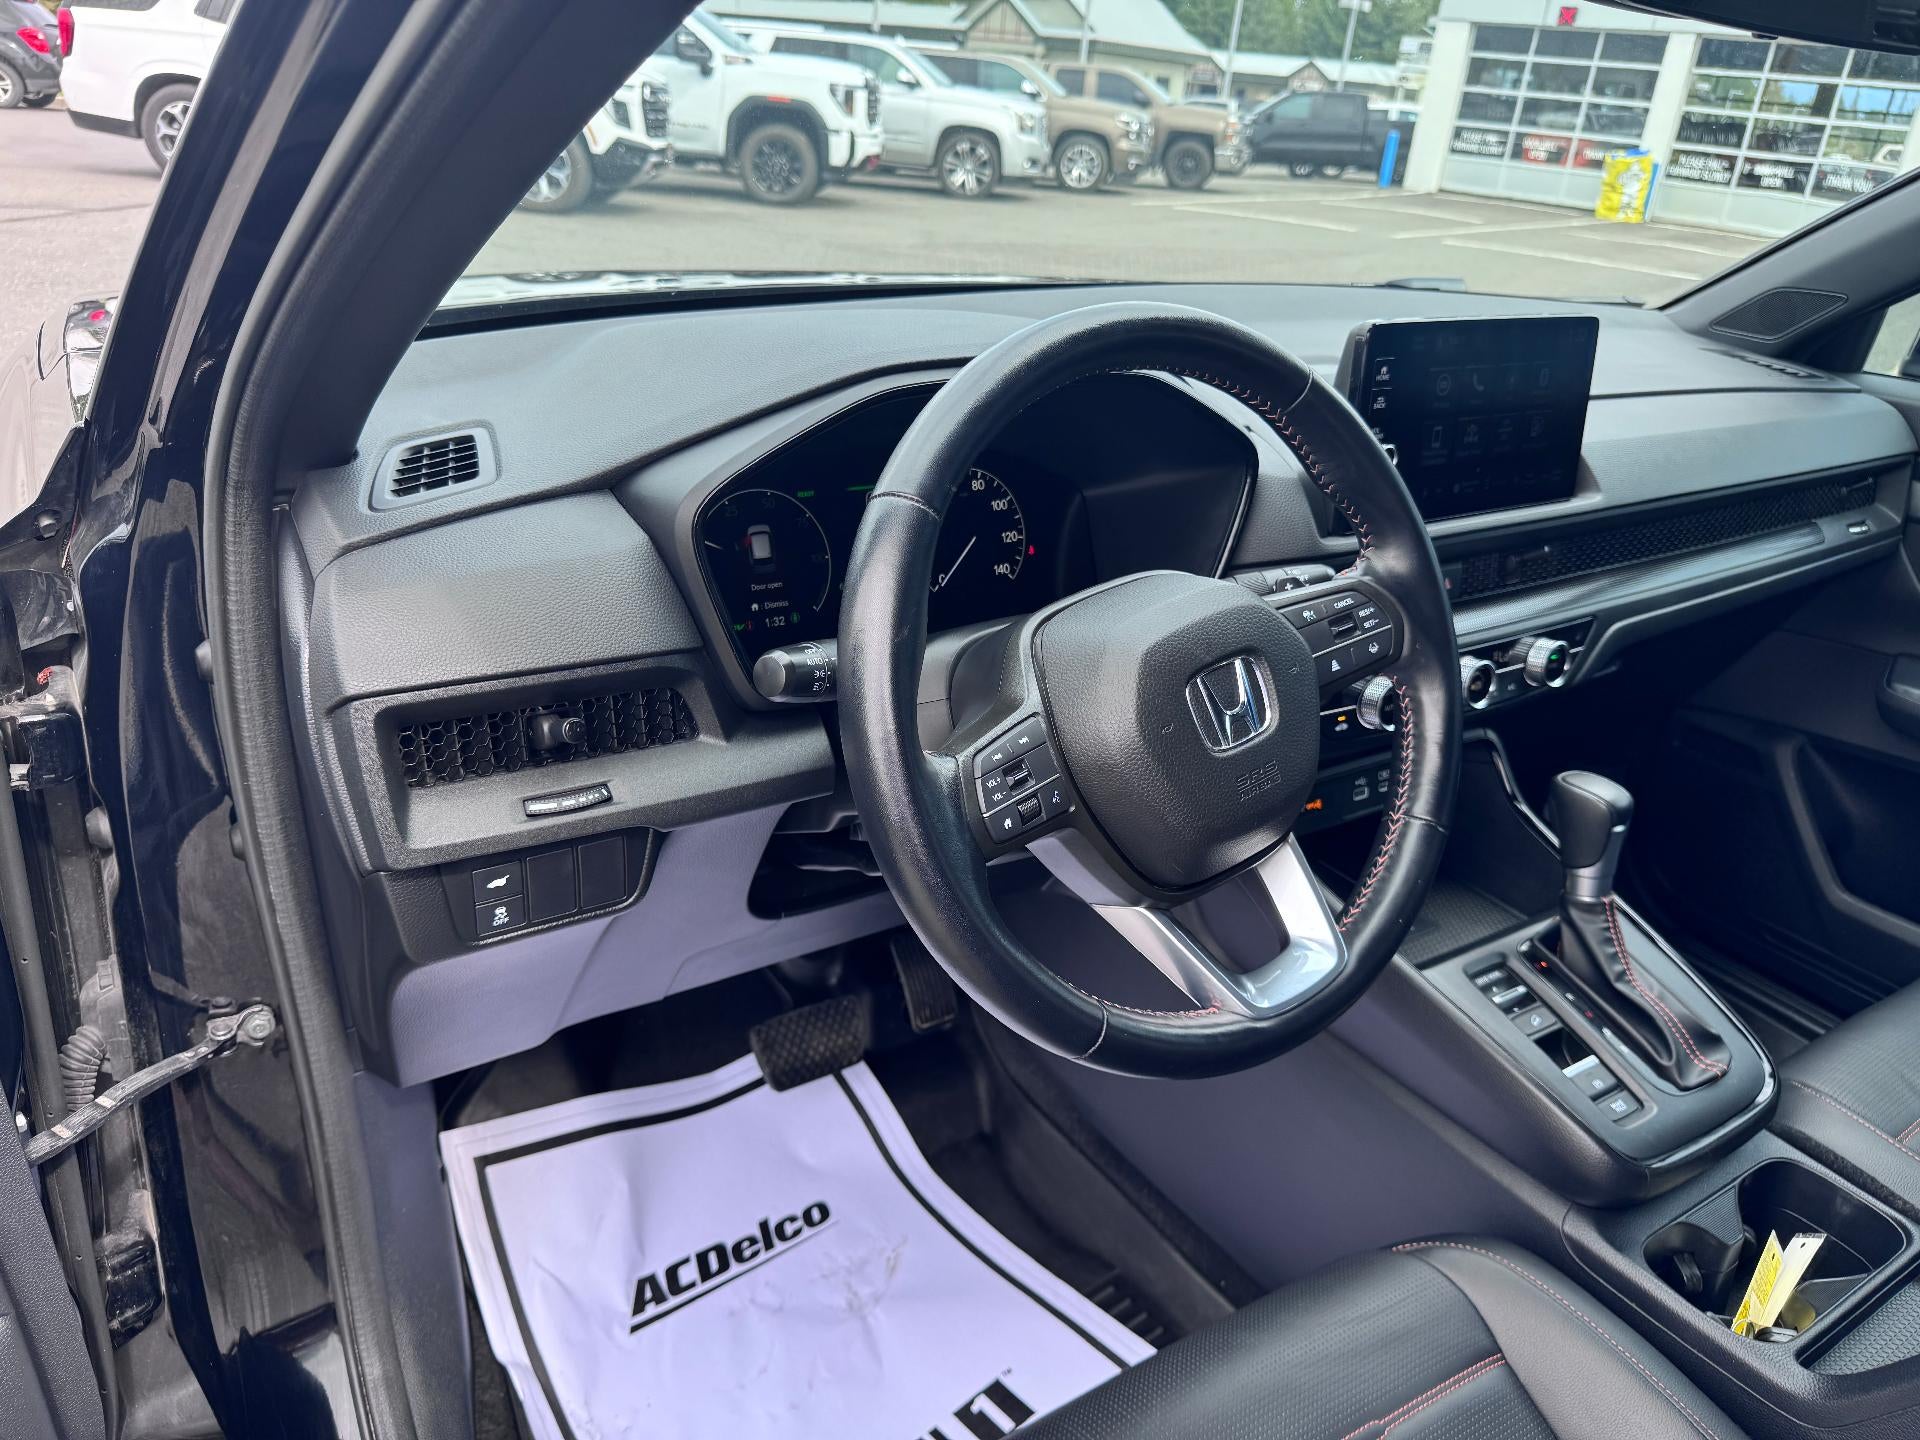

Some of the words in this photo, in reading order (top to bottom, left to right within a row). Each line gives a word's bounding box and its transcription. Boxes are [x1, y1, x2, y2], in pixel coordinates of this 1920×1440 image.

[971, 480, 985, 491] 80
[991, 499, 1008, 511] 100
[1001, 530, 1018, 543] 120
[993, 563, 1010, 576] 140
[751, 583, 767, 591] Door
[767, 582, 783, 590] open
[764, 600, 789, 610] Dismiss
[1333, 597, 1355, 609] CANCEL
[765, 615, 785, 628] 1:32
[806, 657, 824, 666] AUTO
[492, 916, 510, 927] OFF
[631, 1200, 831, 1318] ACDelco
